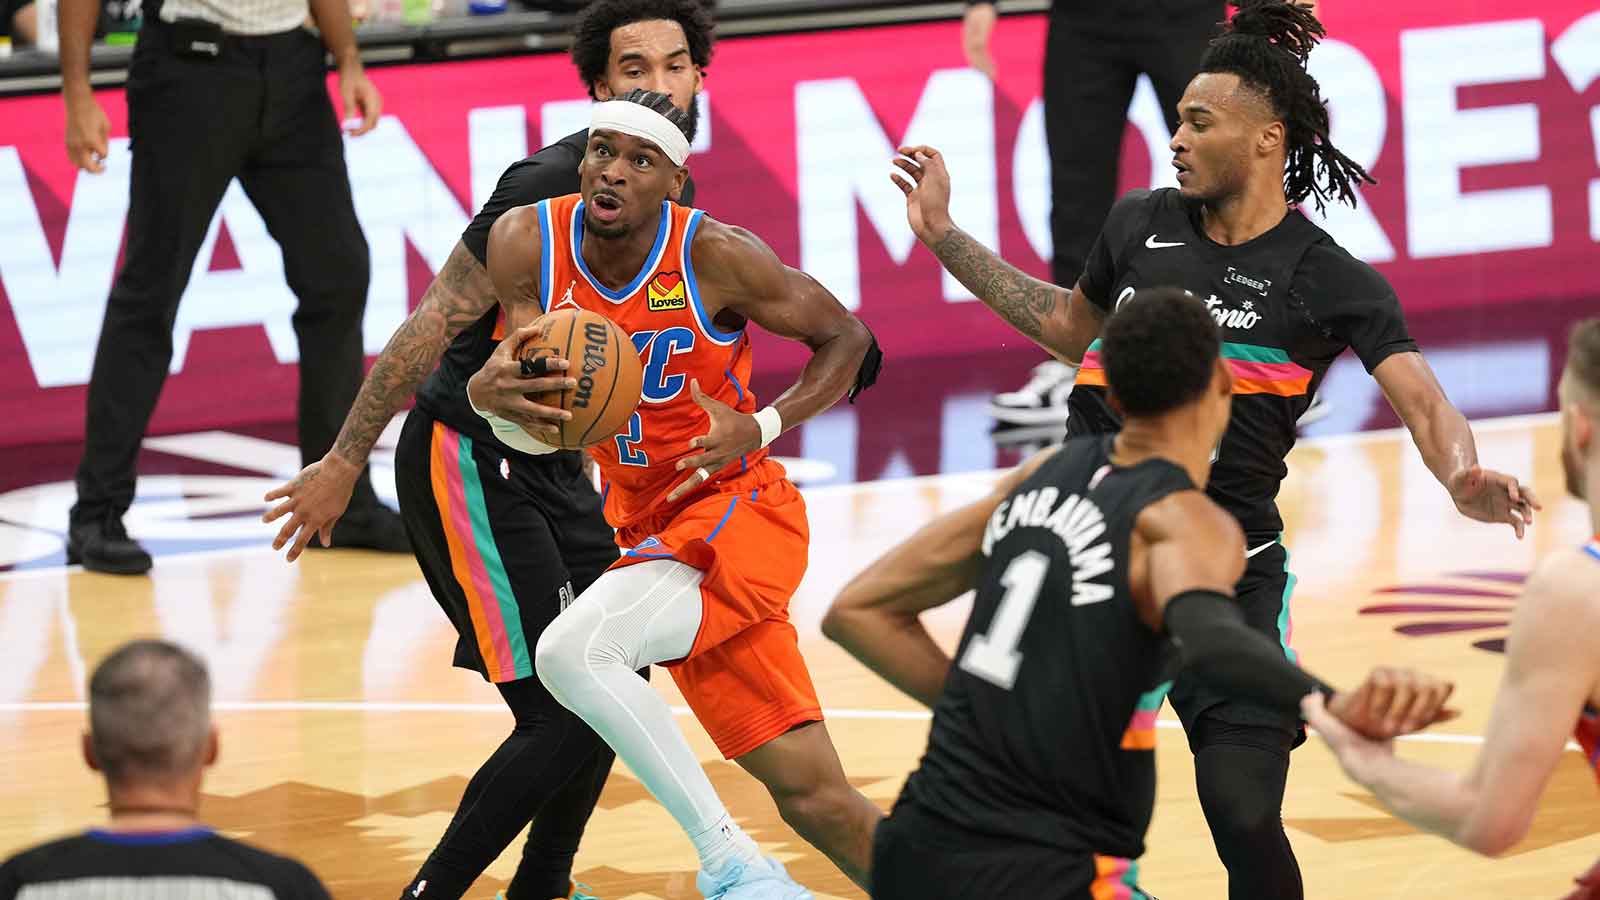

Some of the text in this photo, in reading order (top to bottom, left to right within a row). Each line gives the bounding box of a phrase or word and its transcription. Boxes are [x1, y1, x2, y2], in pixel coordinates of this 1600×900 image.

[1230, 272, 1265, 290] LEDGER
[573, 322, 608, 408] Wilson
[615, 411, 648, 467] 2
[959, 549, 1050, 691] 1
